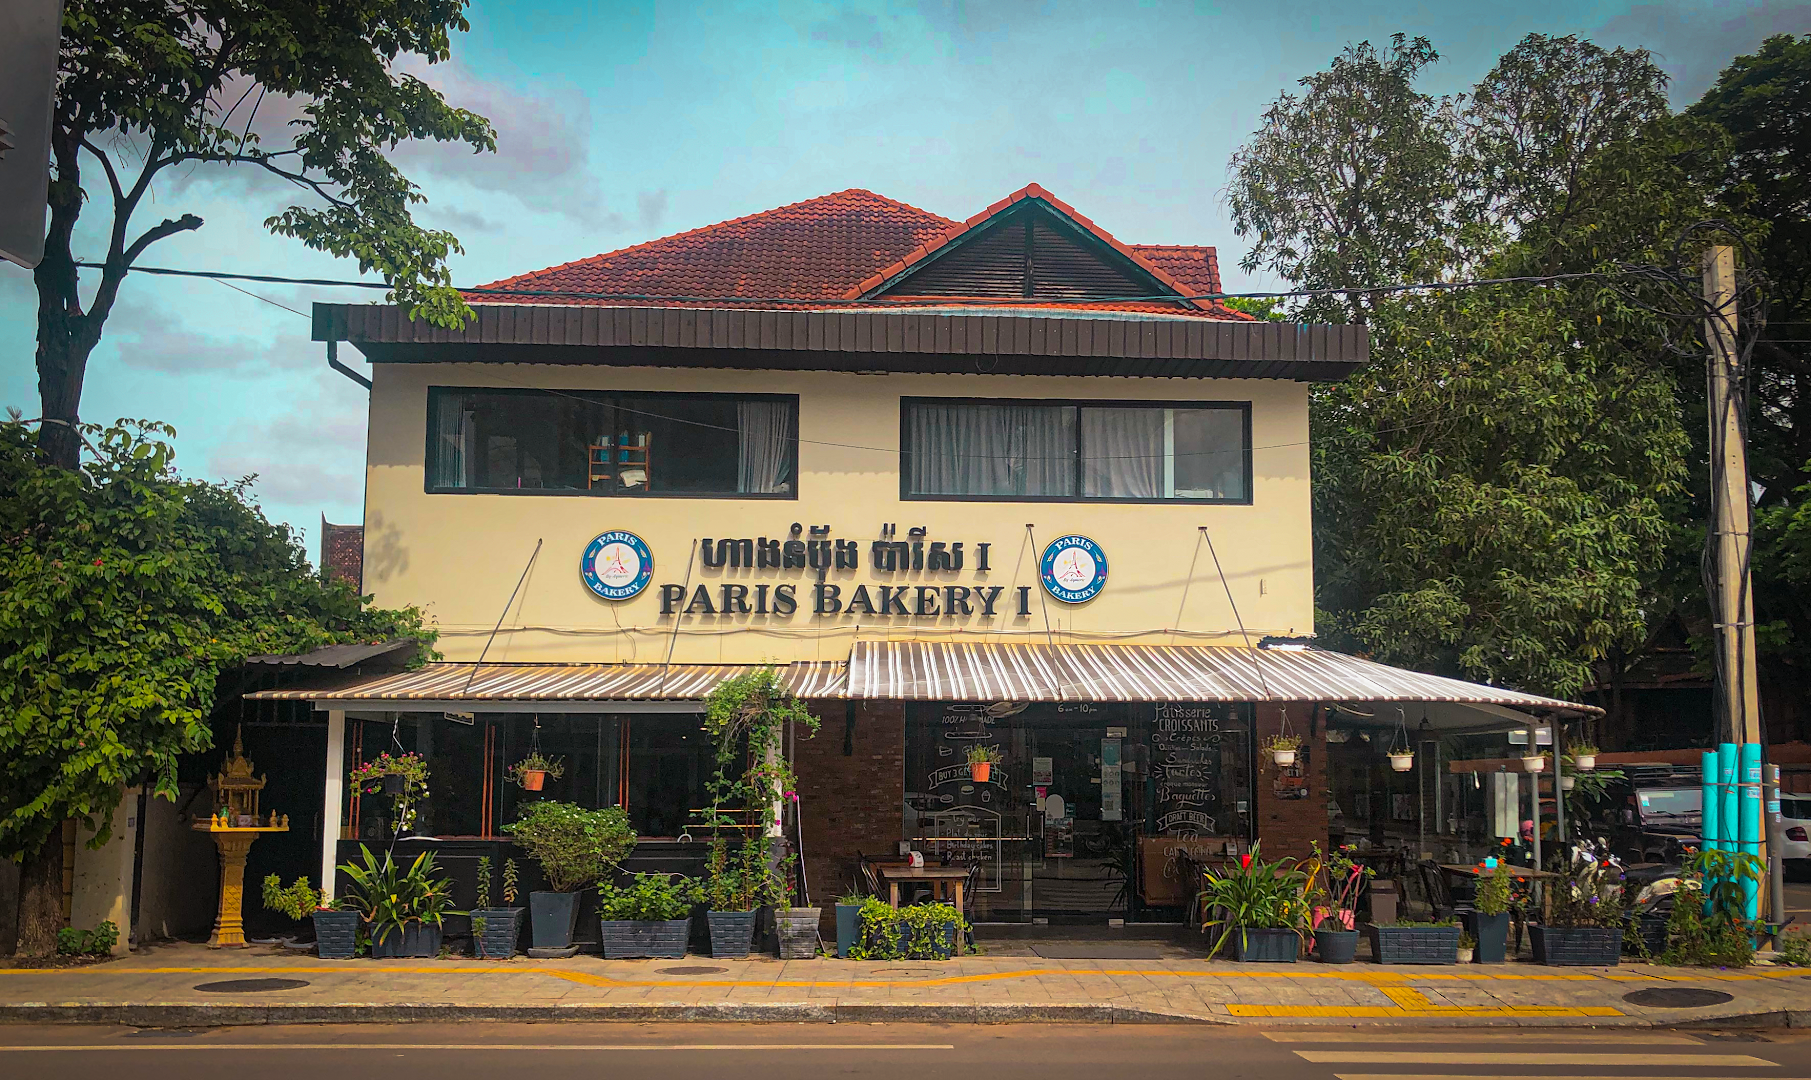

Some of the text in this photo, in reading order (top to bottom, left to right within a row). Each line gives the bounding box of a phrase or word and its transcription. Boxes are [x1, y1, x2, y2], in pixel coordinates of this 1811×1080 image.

[596, 532, 638, 547] PARIS
[1055, 537, 1093, 550] PARIS
[593, 582, 640, 597] BAKERY
[1051, 585, 1096, 600] BAKERY
[660, 584, 1031, 616] PARIS BAKERY I
[1159, 719, 1219, 732] CROISSANTS
[938, 770, 951, 781] BUY
[952, 769, 958, 778] 3
[1161, 763, 1202, 779] Tartes
[1156, 785, 1216, 810] Baguettes
[1168, 811, 1205, 824] DRAFT BEER
